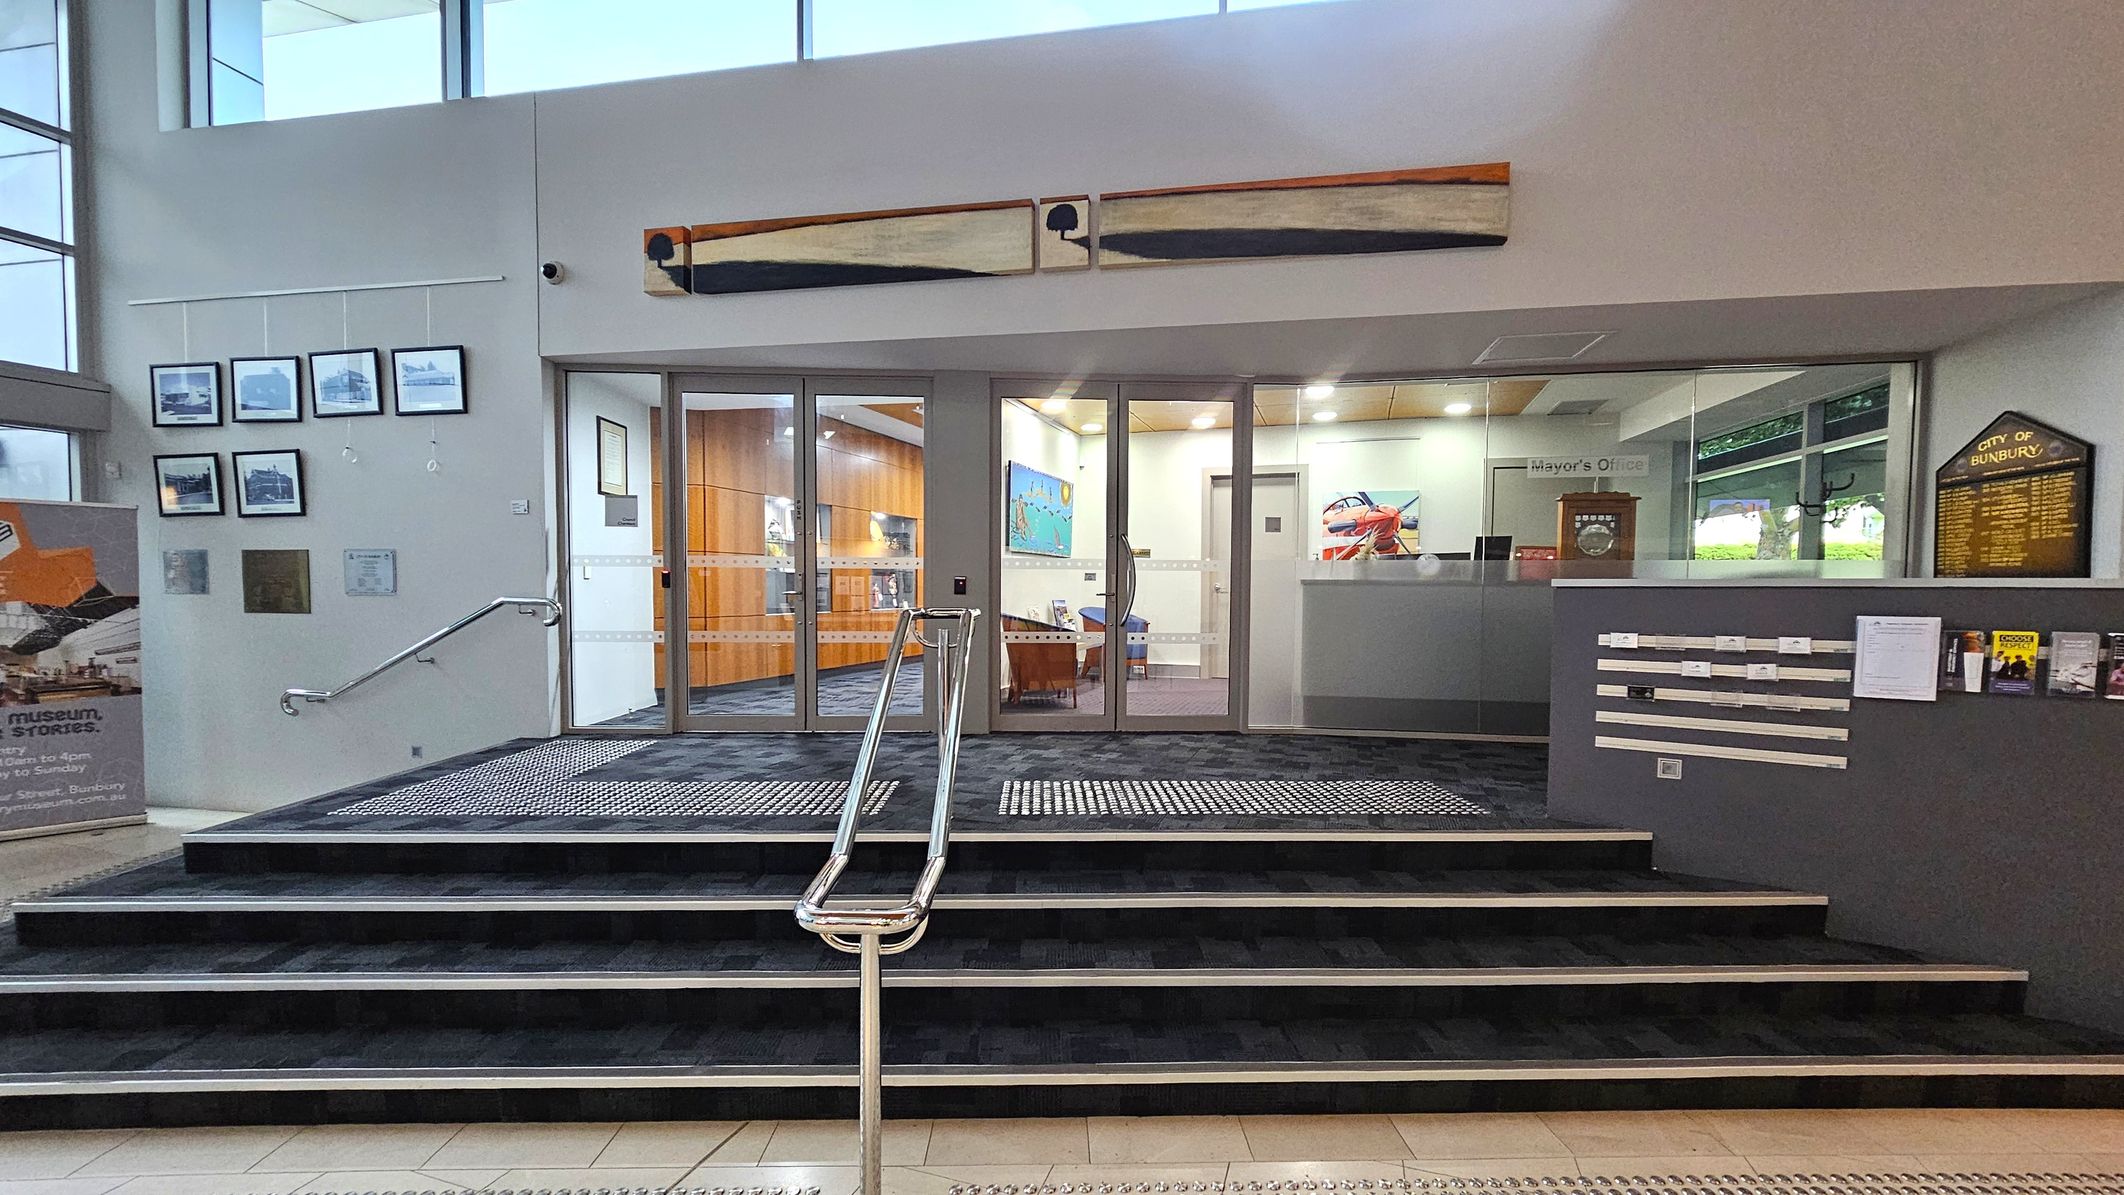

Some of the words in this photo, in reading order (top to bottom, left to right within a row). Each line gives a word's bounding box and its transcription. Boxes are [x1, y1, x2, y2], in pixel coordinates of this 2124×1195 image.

[1978, 433, 2008, 451] CITY
[2015, 431, 2034, 441] OF
[1971, 444, 2043, 466] BUNBURY
[1531, 459, 1592, 475] Mayor's
[1598, 458, 1644, 471] Office
[40, 755, 56, 763] to
[60, 752, 92, 762] 4pm
[34, 764, 87, 775] Sunday
[69, 783, 125, 793] Bunbury
